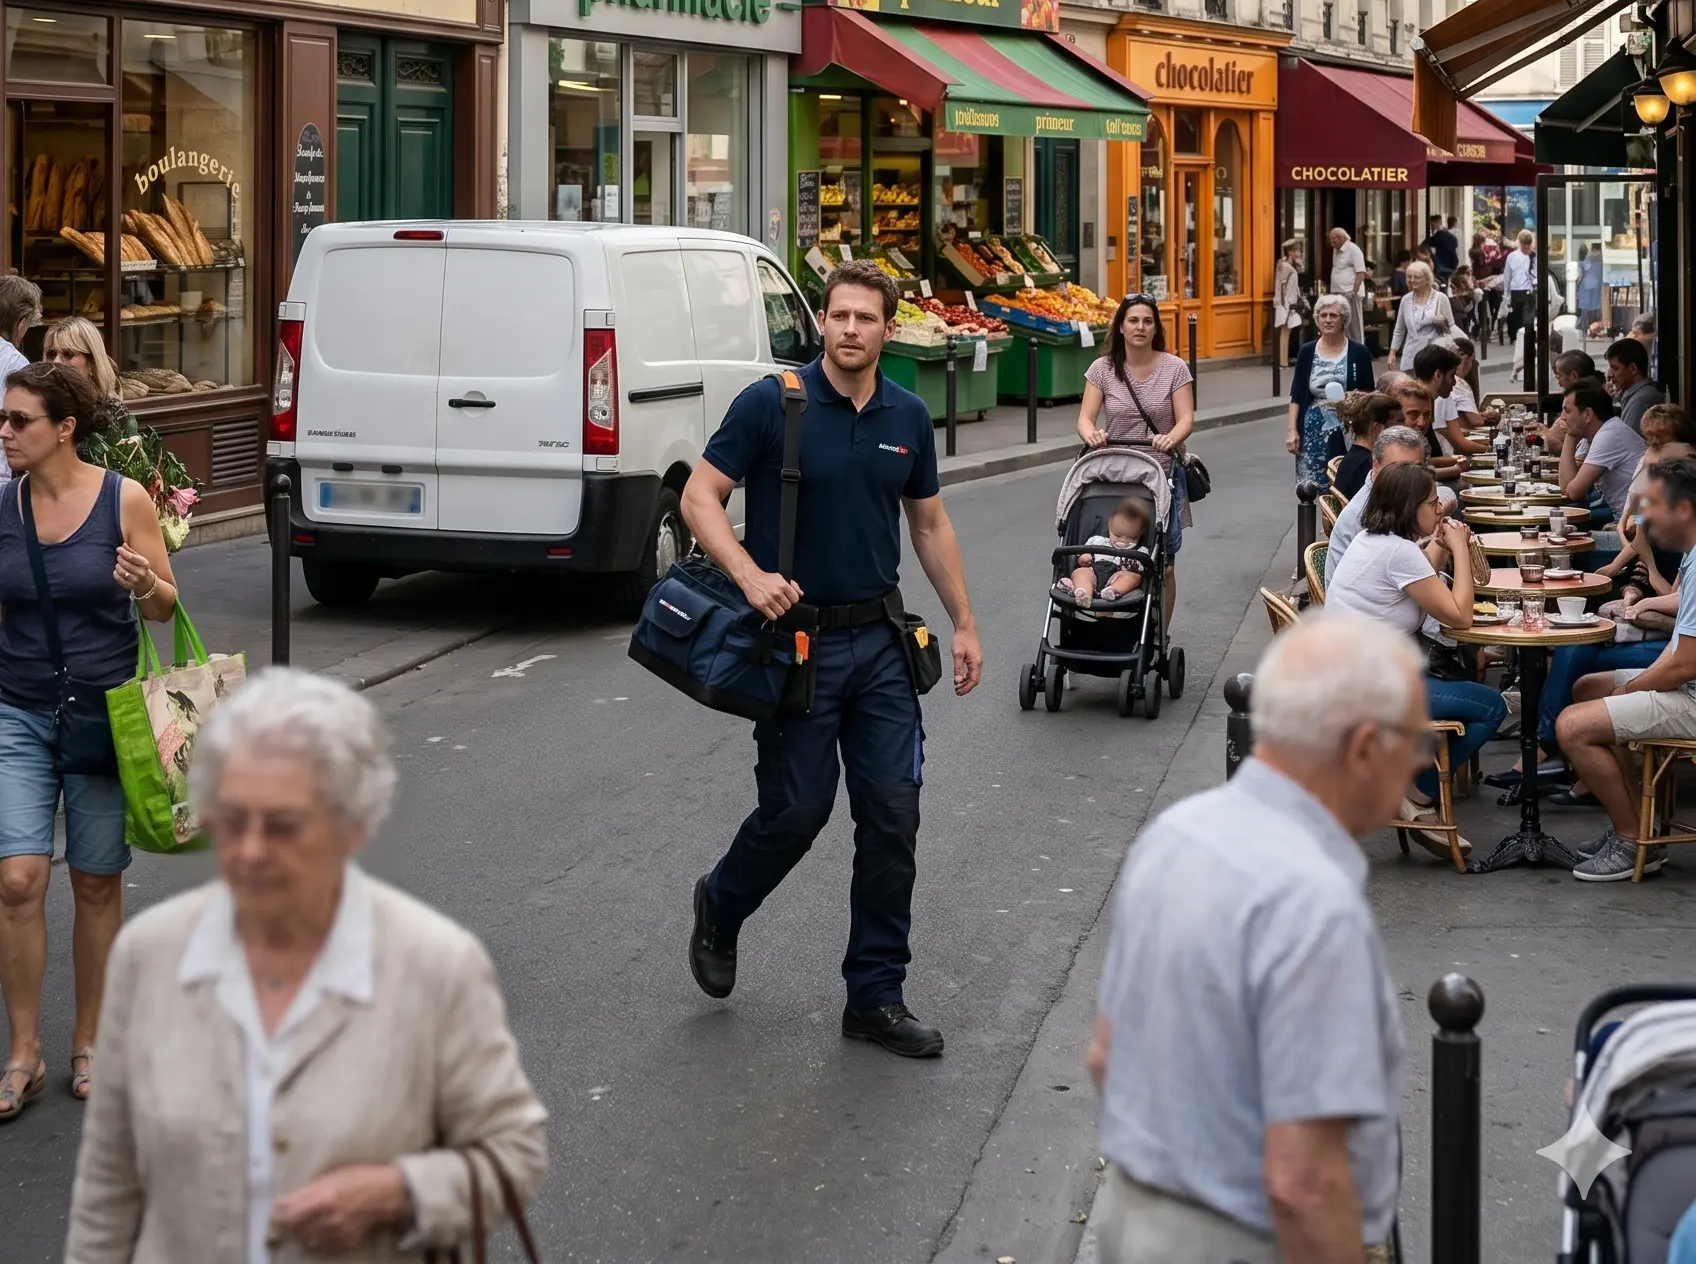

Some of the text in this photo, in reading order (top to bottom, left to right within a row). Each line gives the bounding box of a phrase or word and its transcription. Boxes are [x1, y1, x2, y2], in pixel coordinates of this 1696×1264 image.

[1155, 51, 1255, 95] chocolatier
[134, 146, 240, 198] boulangerie
[1291, 166, 1408, 182] CHOCOLATIER
